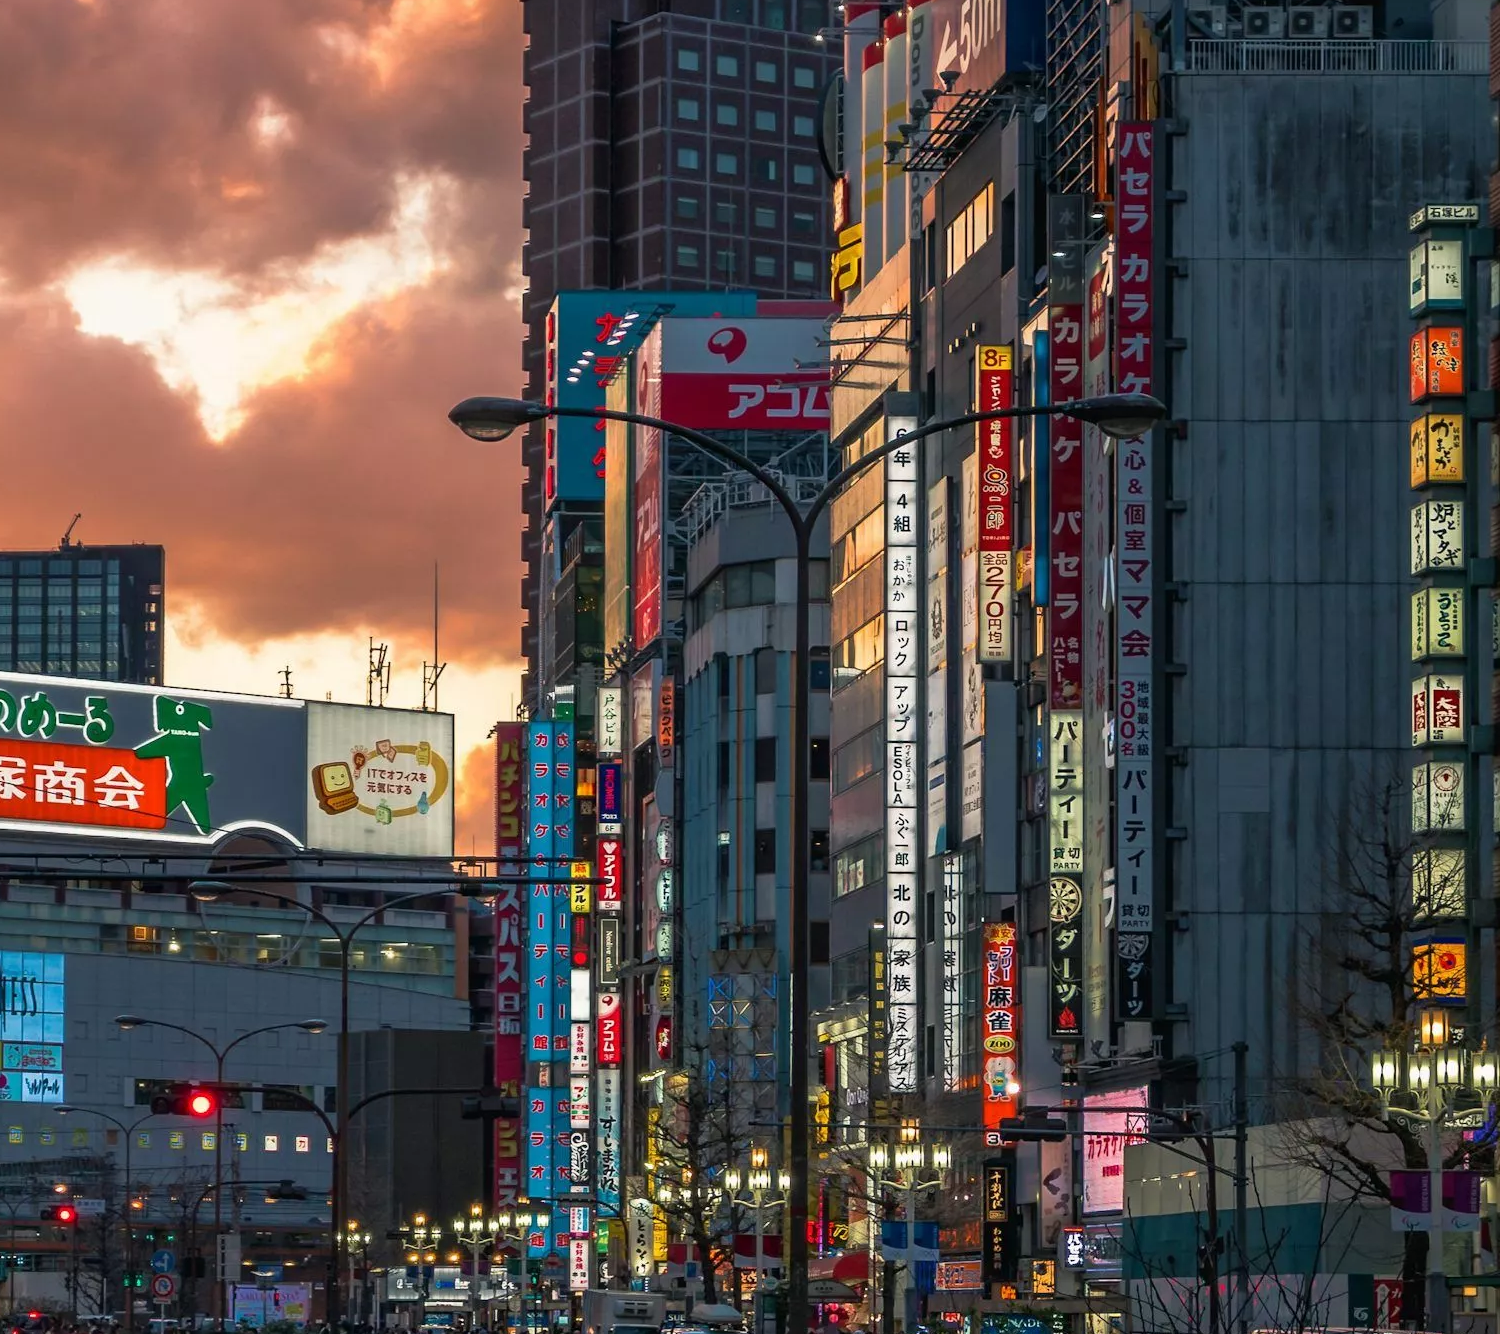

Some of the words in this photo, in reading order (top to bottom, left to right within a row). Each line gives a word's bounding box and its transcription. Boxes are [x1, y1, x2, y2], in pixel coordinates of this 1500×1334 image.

[910, 16, 924, 87] Don
[1119, 132, 1150, 234] パセラ
[1429, 206, 1477, 220] 石塚ビル
[1120, 254, 1150, 396] カラオケ
[983, 348, 1008, 367] 8F
[728, 383, 831, 419] アコム
[892, 558, 907, 603] おかか
[982, 552, 1009, 566] 全品
[1052, 511, 1082, 620] パセラ
[984, 566, 1005, 651] 270円均一
[1120, 559, 1151, 659] ママ会
[1052, 636, 1065, 683] ハニトー
[1066, 636, 1080, 665] 名物
[893, 620, 911, 733] ロックアップ
[603, 693, 617, 748] 戸谷ビル
[1120, 680, 1136, 757] 300名
[1136, 681, 1150, 757] 地域最大級
[366, 767, 428, 784] ITでオフィスを
[366, 782, 413, 797] 元気にする
[499, 737, 520, 838] パチンコ
[606, 768, 616, 810] PROMISE
[892, 746, 903, 805] ESOLA
[1054, 720, 1078, 839] パーティー
[604, 824, 615, 833] 6F
[894, 813, 910, 867] ふぐ一郎
[1122, 769, 1148, 895] パーティー
[603, 853, 617, 900] アイフル
[1052, 847, 1081, 860] 貸切
[1052, 861, 1081, 870] PARTY
[533, 732, 549, 1050] カラオケ&パーティー館
[574, 904, 586, 912] 6F
[604, 901, 616, 910] 5F
[1121, 904, 1150, 918] 貸切
[892, 884, 912, 993] 北の家族
[1121, 919, 1150, 928] PARTY
[987, 951, 1000, 984] セット
[1001, 946, 1013, 982] フリー
[1055, 927, 1079, 1004] ダーツ
[987, 987, 1012, 1031] 麻雀
[1126, 961, 1145, 1017] ダーツ
[603, 1020, 616, 1052] アコム
[603, 1053, 615, 1061] 3F
[895, 1007, 910, 1093] ミステリアス
[988, 1037, 1011, 1050] ZOO
[599, 1116, 619, 1194] すしまみれ
